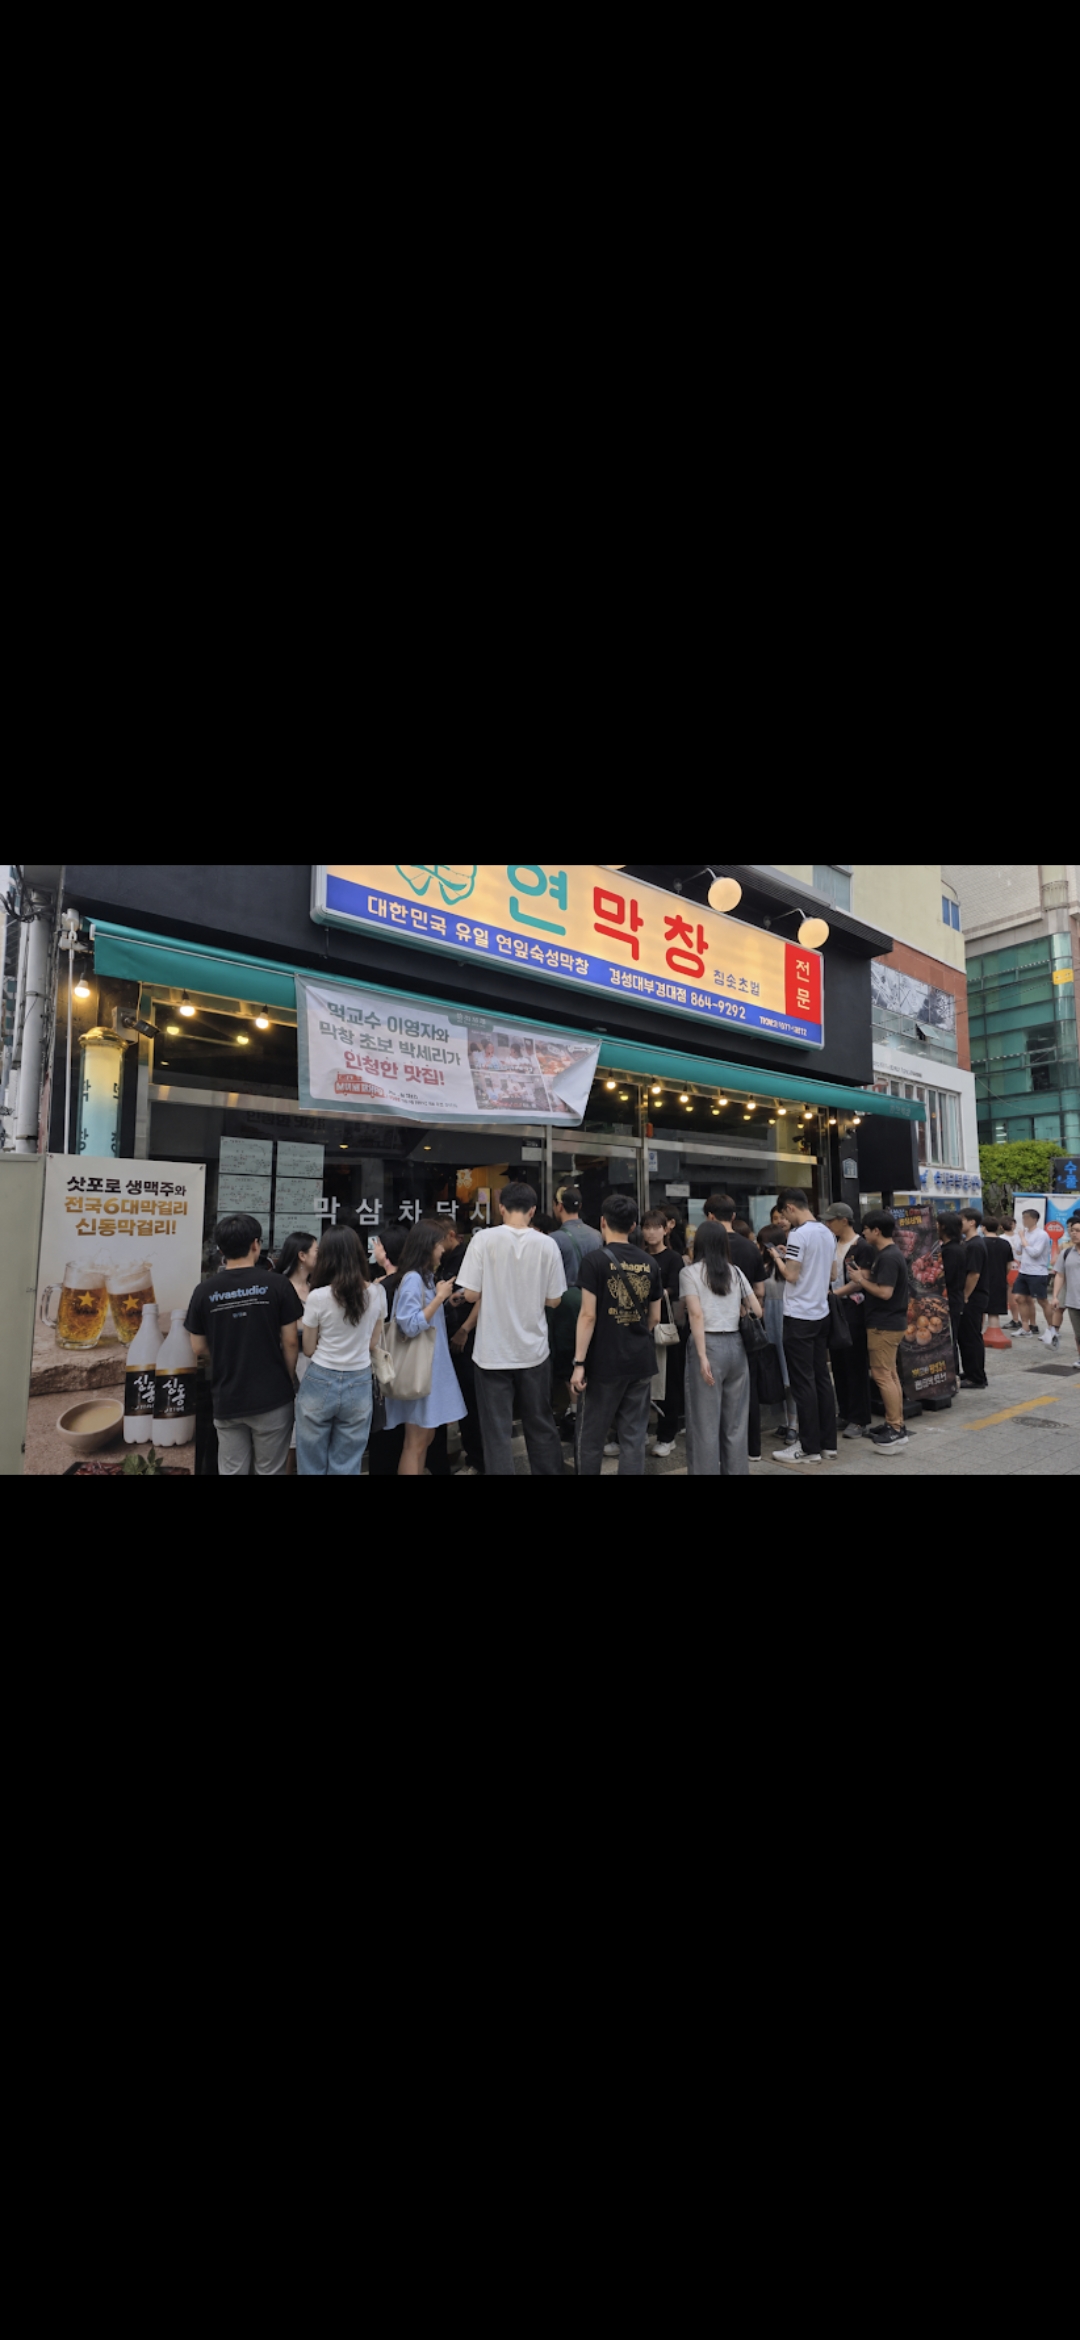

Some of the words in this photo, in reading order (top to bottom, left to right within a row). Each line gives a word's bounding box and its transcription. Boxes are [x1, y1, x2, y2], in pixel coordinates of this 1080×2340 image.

[367, 895, 447, 936] 대한민국
[456, 923, 489, 949] 유일
[496, 934, 590, 975] 연잎숙성막창
[609, 968, 687, 1004] 경성대부경대점
[690, 991, 746, 1019] 864-9292
[796, 959, 811, 1011] 전문
[319, 1021, 355, 1046] 막창
[360, 1033, 395, 1054] 초보
[398, 1040, 461, 1066] 박세리가
[327, 1001, 382, 1030] 먹교수
[387, 1015, 450, 1043] 이영자와
[404, 1063, 446, 1086] 맛집!
[67, 1176, 122, 1194] 삿포로
[125, 1179, 187, 1197] 생맥주와
[75, 1217, 177, 1237] 신동막걸리!
